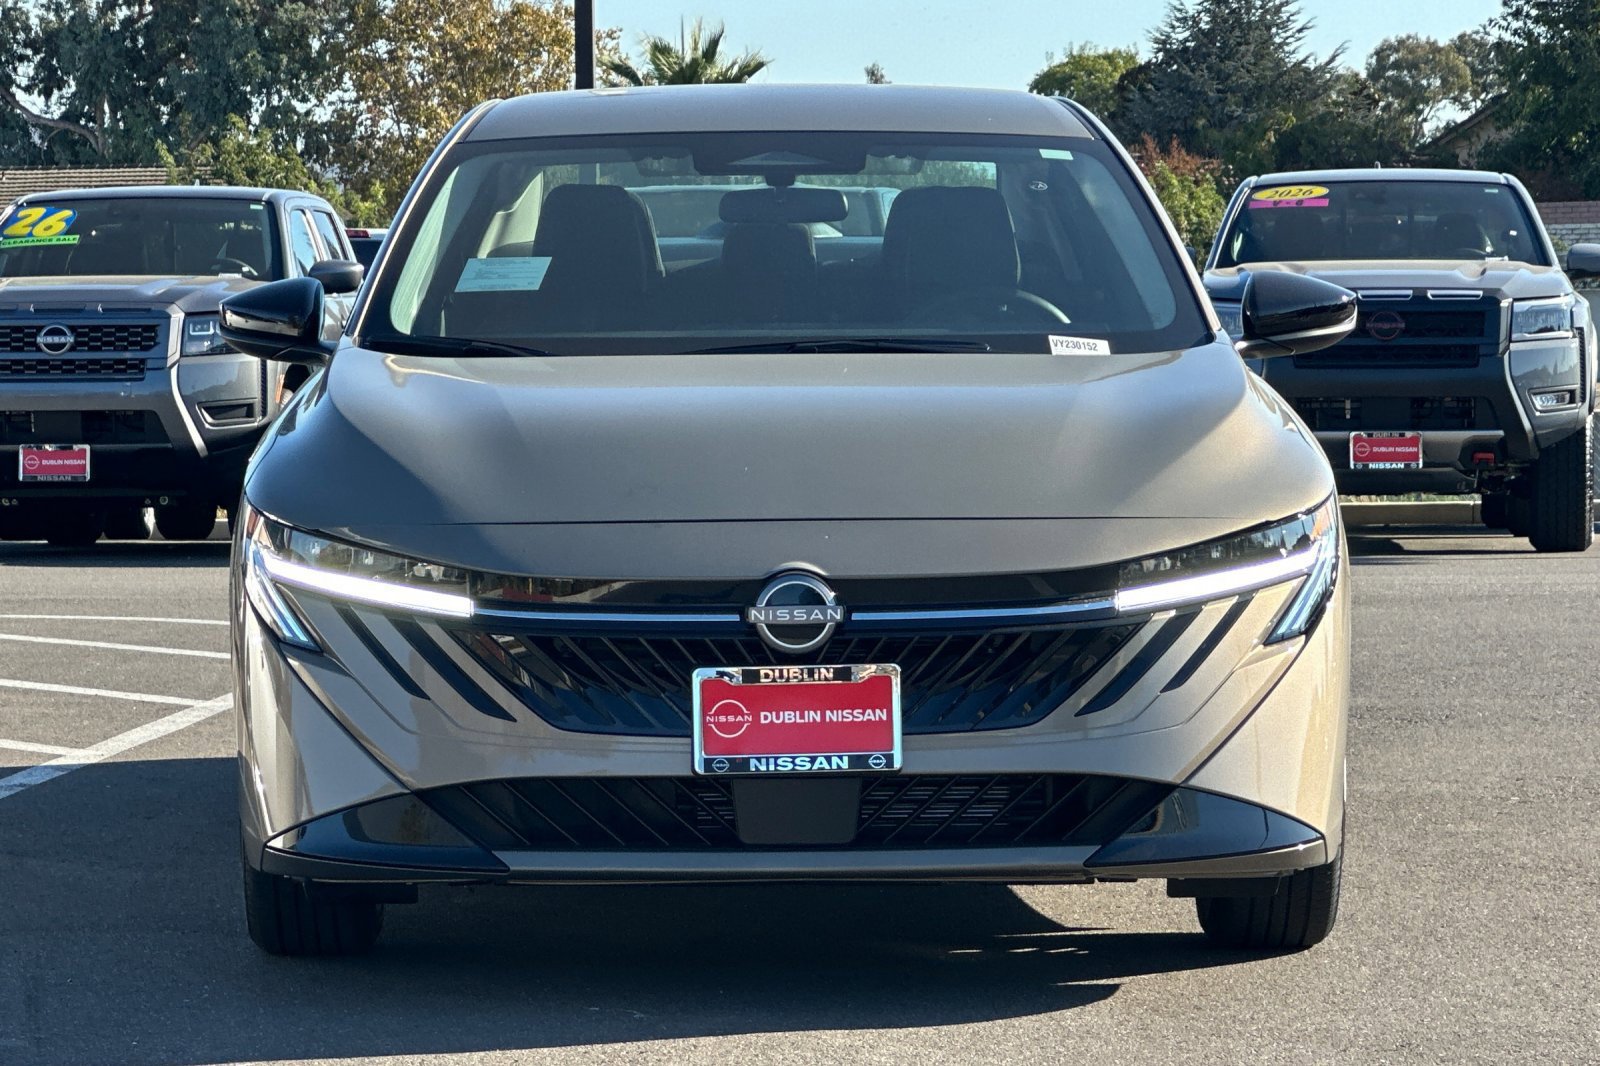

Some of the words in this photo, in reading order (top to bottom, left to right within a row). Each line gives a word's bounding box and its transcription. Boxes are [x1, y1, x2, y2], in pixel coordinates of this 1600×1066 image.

[1266, 188, 1313, 199] 2026
[3, 207, 73, 237] 26
[2, 238, 54, 246] CLEARANCE
[1052, 339, 1098, 352] VY230152
[751, 609, 841, 621] NISSAN
[760, 667, 834, 683] DUBLIN
[706, 715, 753, 723] NISSAN
[760, 710, 821, 724] DUBLIN
[825, 708, 888, 723] NISSAN
[749, 756, 849, 771] NISSAN
